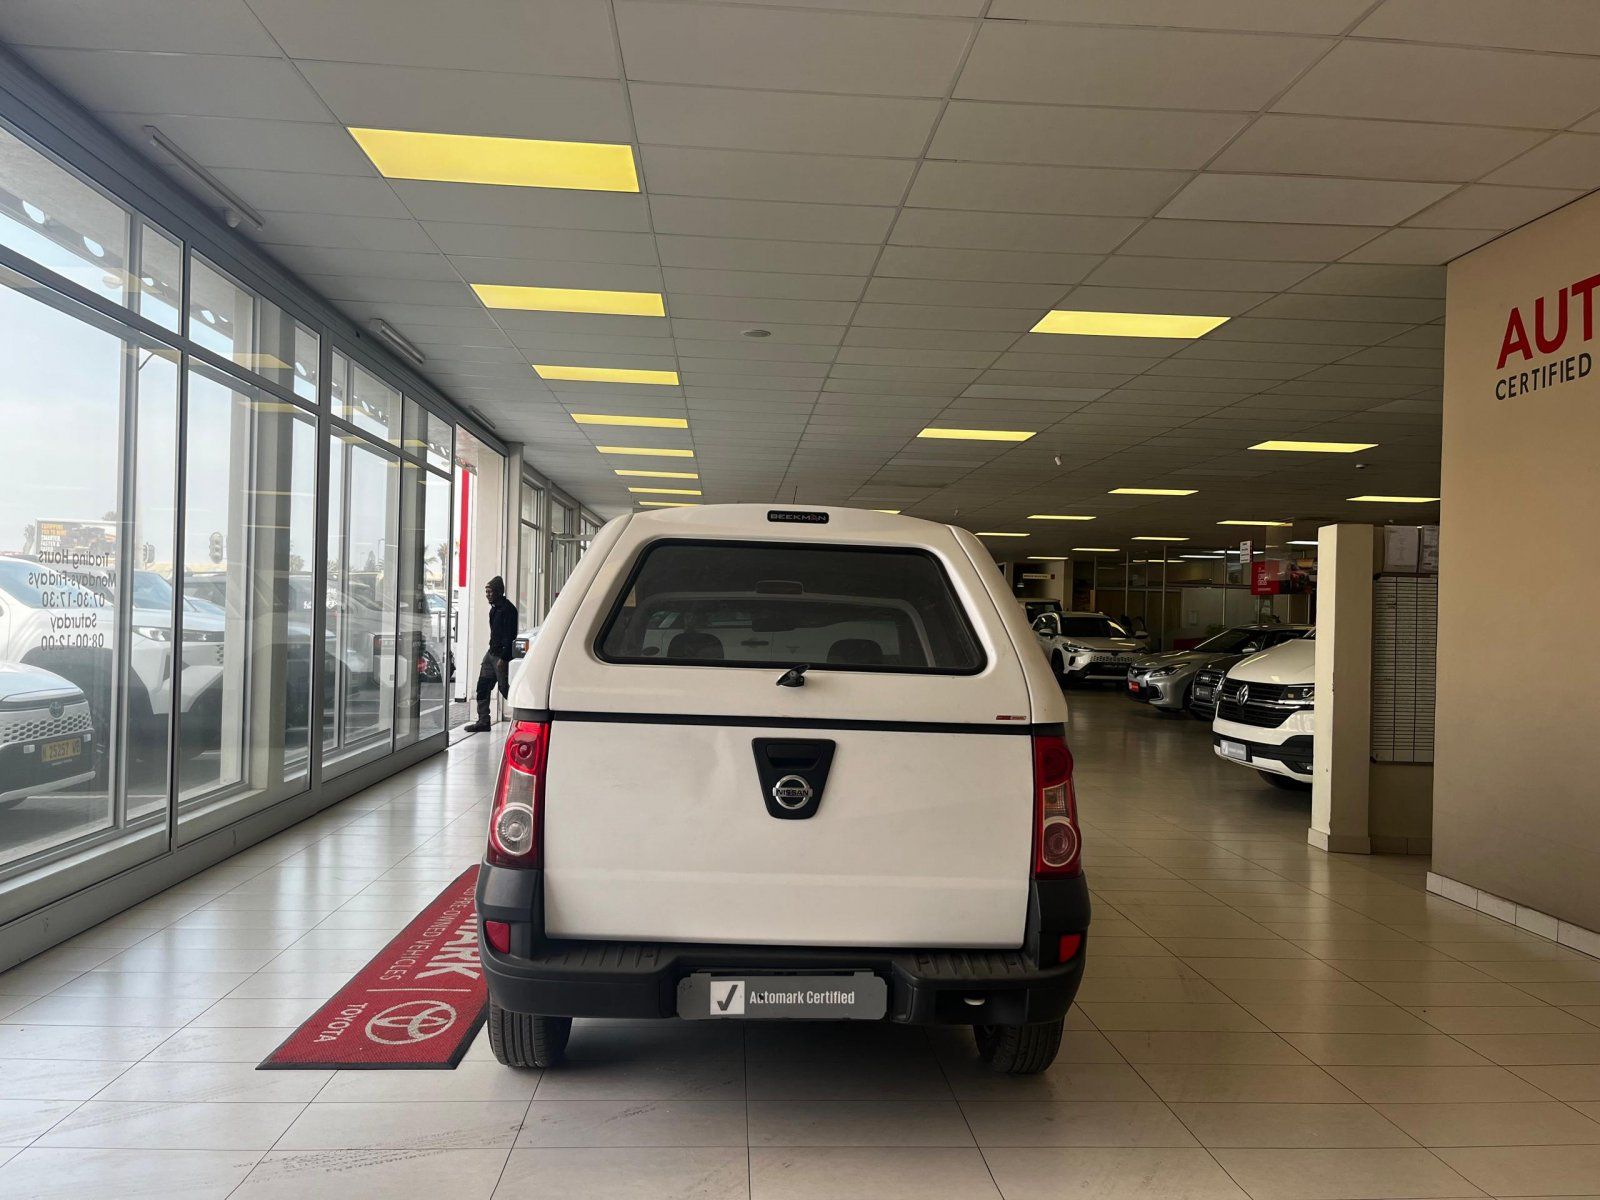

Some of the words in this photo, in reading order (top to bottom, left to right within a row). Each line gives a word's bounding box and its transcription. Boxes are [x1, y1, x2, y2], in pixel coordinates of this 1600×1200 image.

[1496, 273, 1600, 370] AUT
[1495, 352, 1592, 400] CERTIFIED
[423, 896, 475, 937] PRE-OWNED
[380, 940, 437, 980] VEHICLES
[749, 991, 804, 1004] Automark
[806, 991, 855, 1004] Certified
[313, 1003, 369, 1042] TOYOTA
